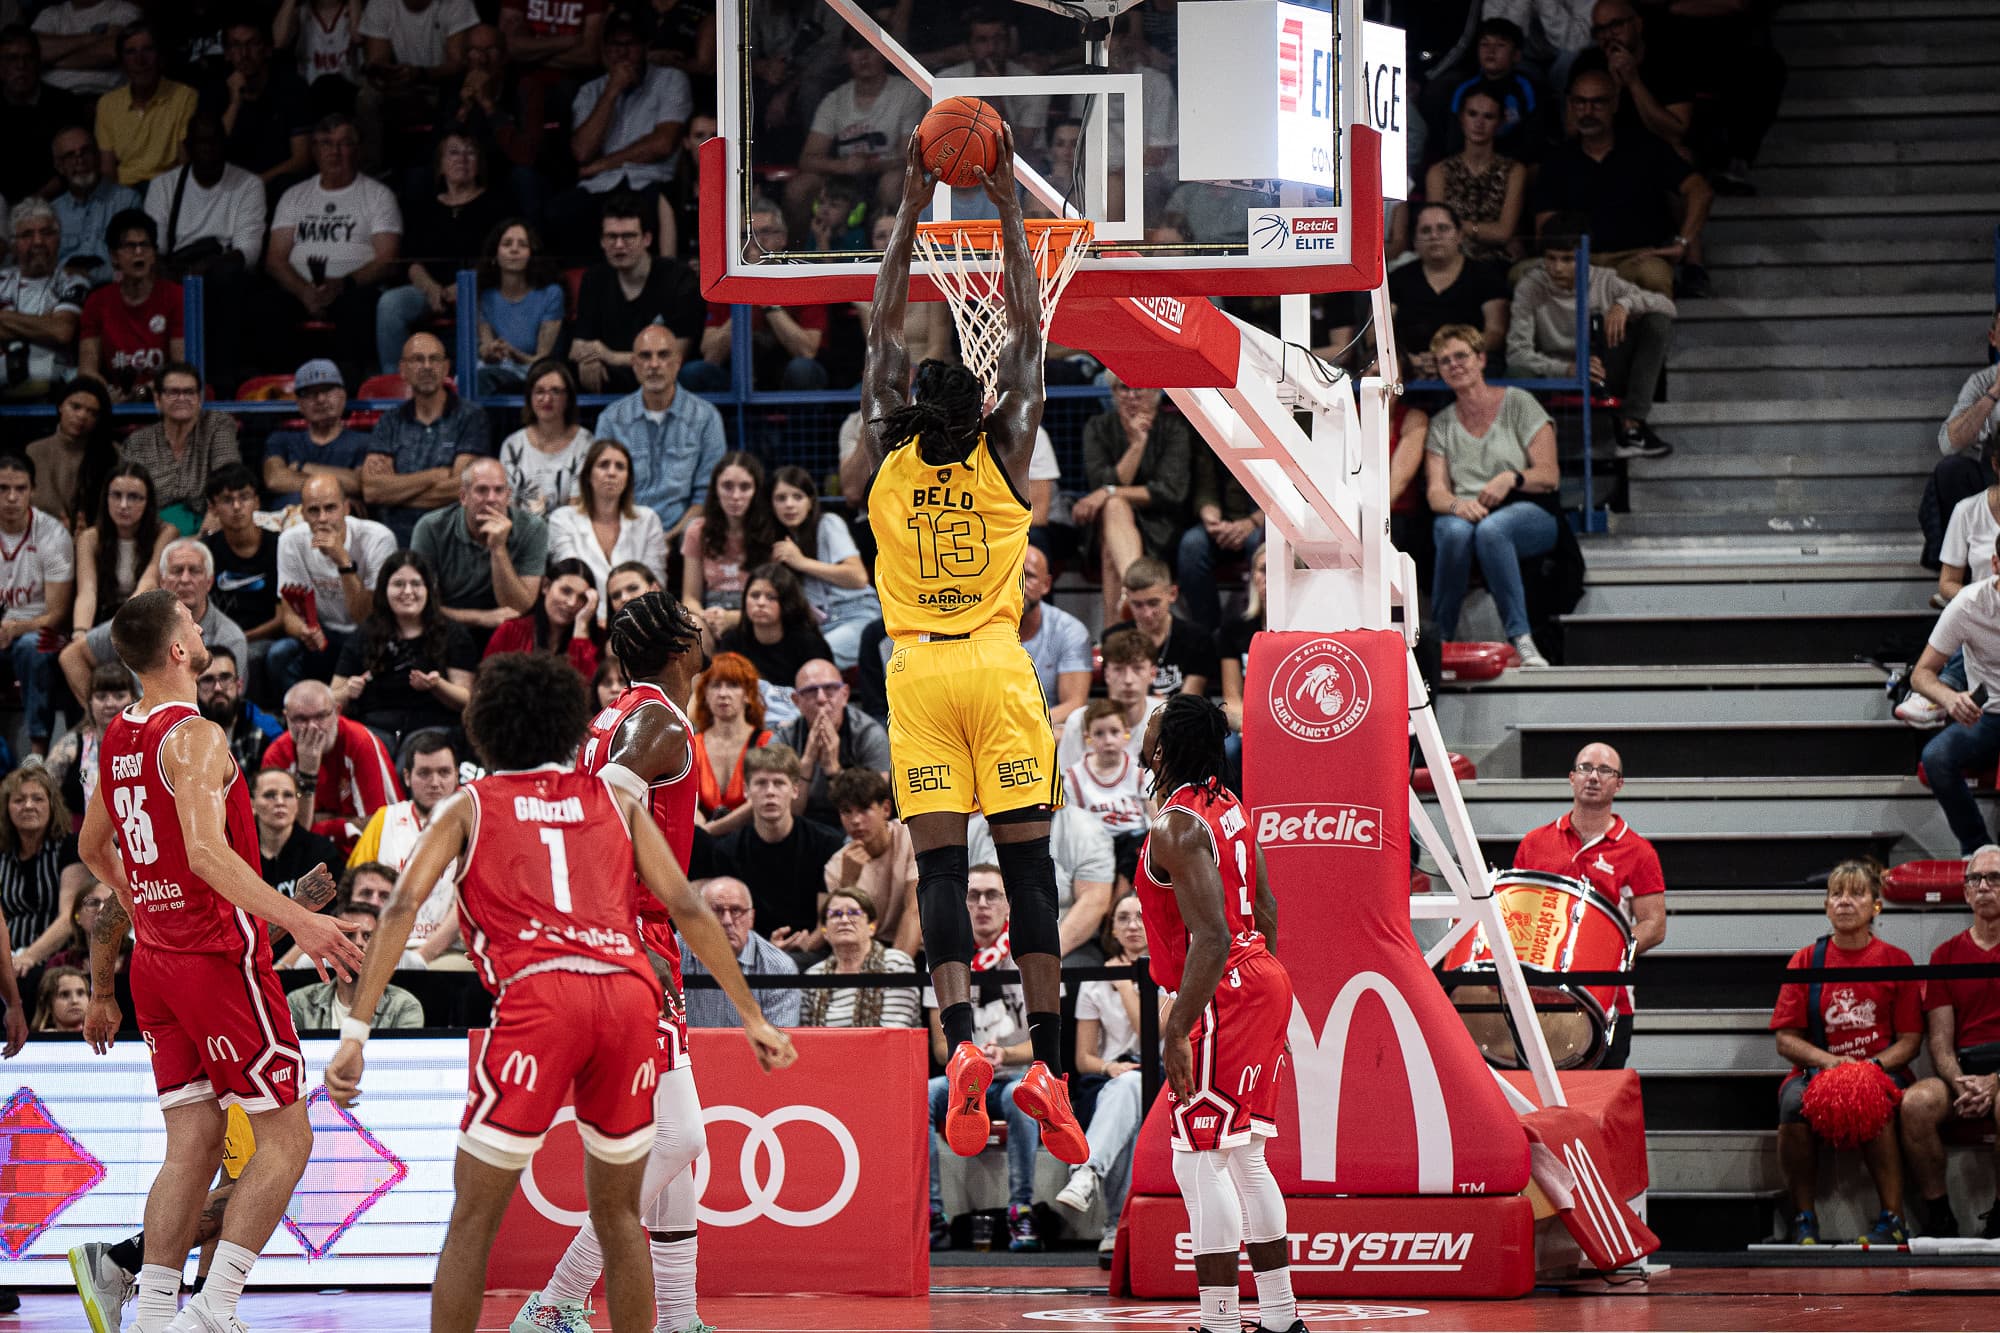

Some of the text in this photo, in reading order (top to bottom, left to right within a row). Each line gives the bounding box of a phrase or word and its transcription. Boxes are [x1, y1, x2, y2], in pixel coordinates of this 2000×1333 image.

[297, 221, 357, 242] NANCY
[1295, 219, 1335, 232] Betclic
[1295, 235, 1335, 250] ÉLITE
[913, 486, 973, 510] BELO
[908, 510, 989, 578] 13
[918, 592, 982, 605] SARRION
[1274, 696, 1366, 738] SLUC NANCY BASKET
[908, 765, 951, 780] BATI
[998, 757, 1039, 775] BATI
[909, 777, 952, 793] SOL
[1000, 771, 1042, 788] SOL
[514, 796, 584, 823] GAUZIN
[1257, 808, 1376, 843] Betclic
[540, 827, 573, 914] 1
[1193, 1115, 1218, 1129] NCY
[1459, 1181, 1486, 1193] TM
[1175, 1232, 1474, 1271] STSYSTEM
